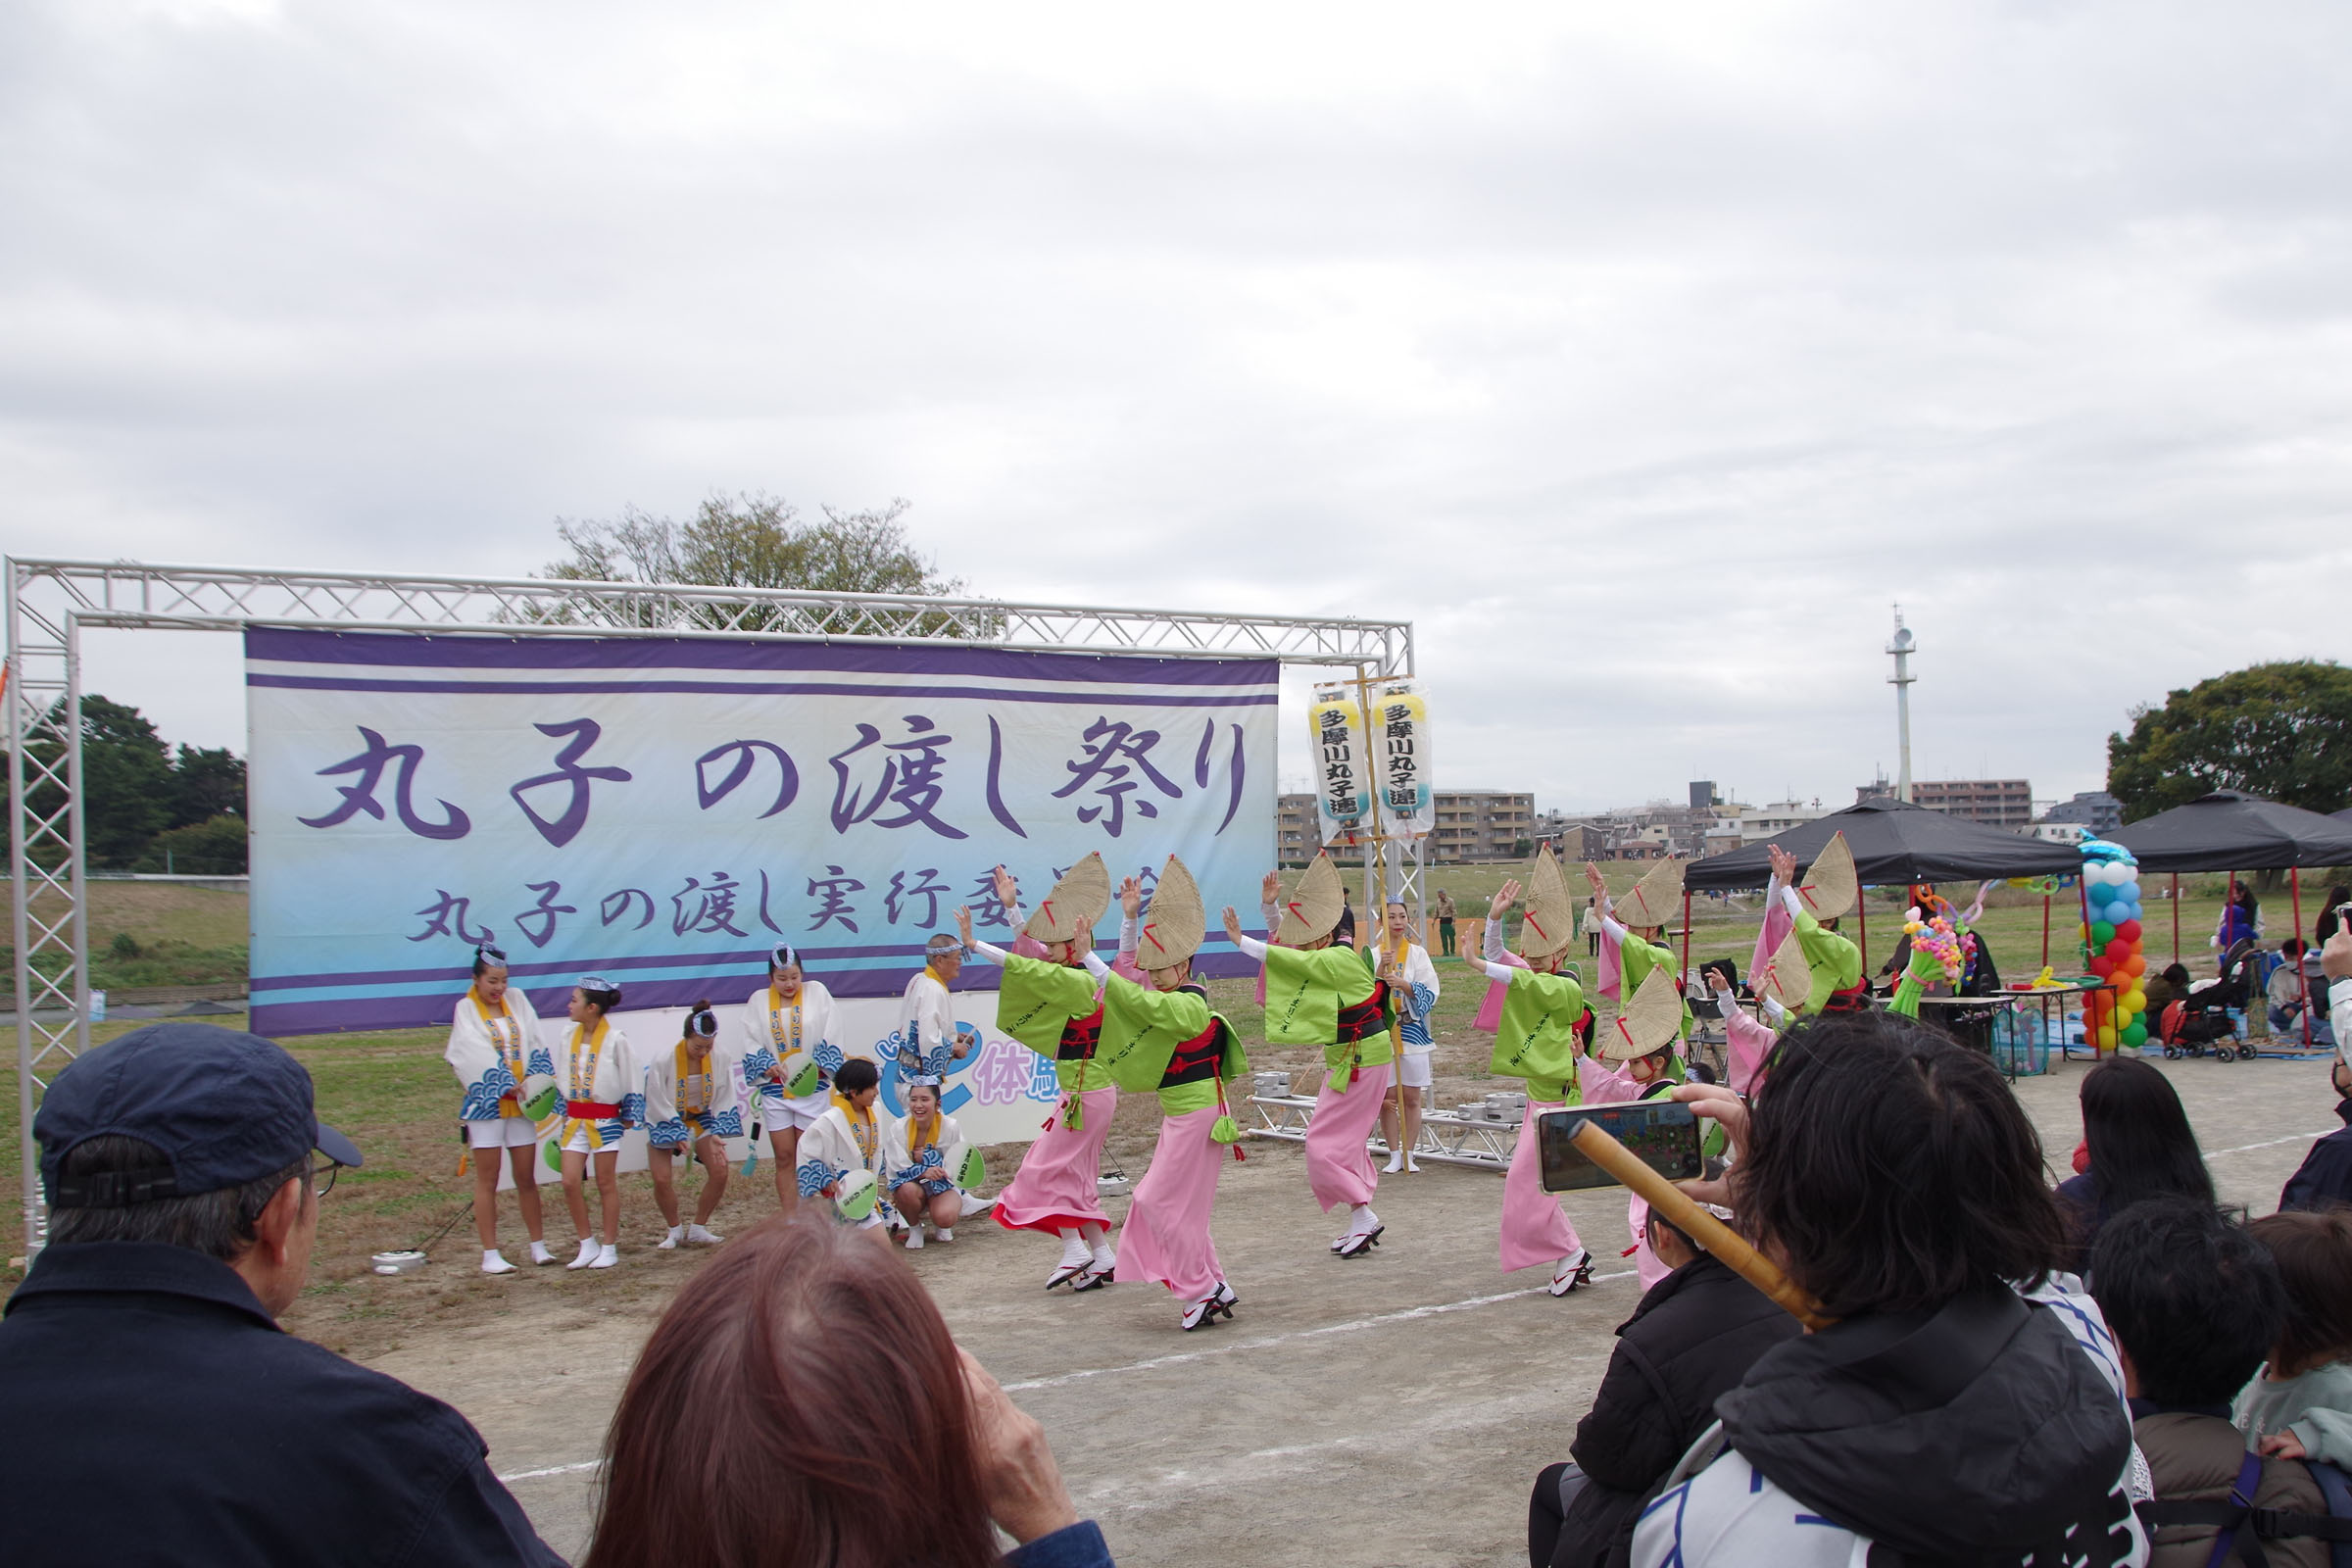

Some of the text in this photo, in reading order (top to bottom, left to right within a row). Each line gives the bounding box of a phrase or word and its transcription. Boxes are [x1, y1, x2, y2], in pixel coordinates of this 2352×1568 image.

[296, 713, 1246, 849] 丸子の渡し祭り
[1319, 709, 1358, 815] 多摩川丸子連
[1384, 704, 1417, 806] 多摩川丸子連
[405, 863, 1160, 949] 丸子の渡し実行委
[792, 1005, 802, 1049] まりこ連
